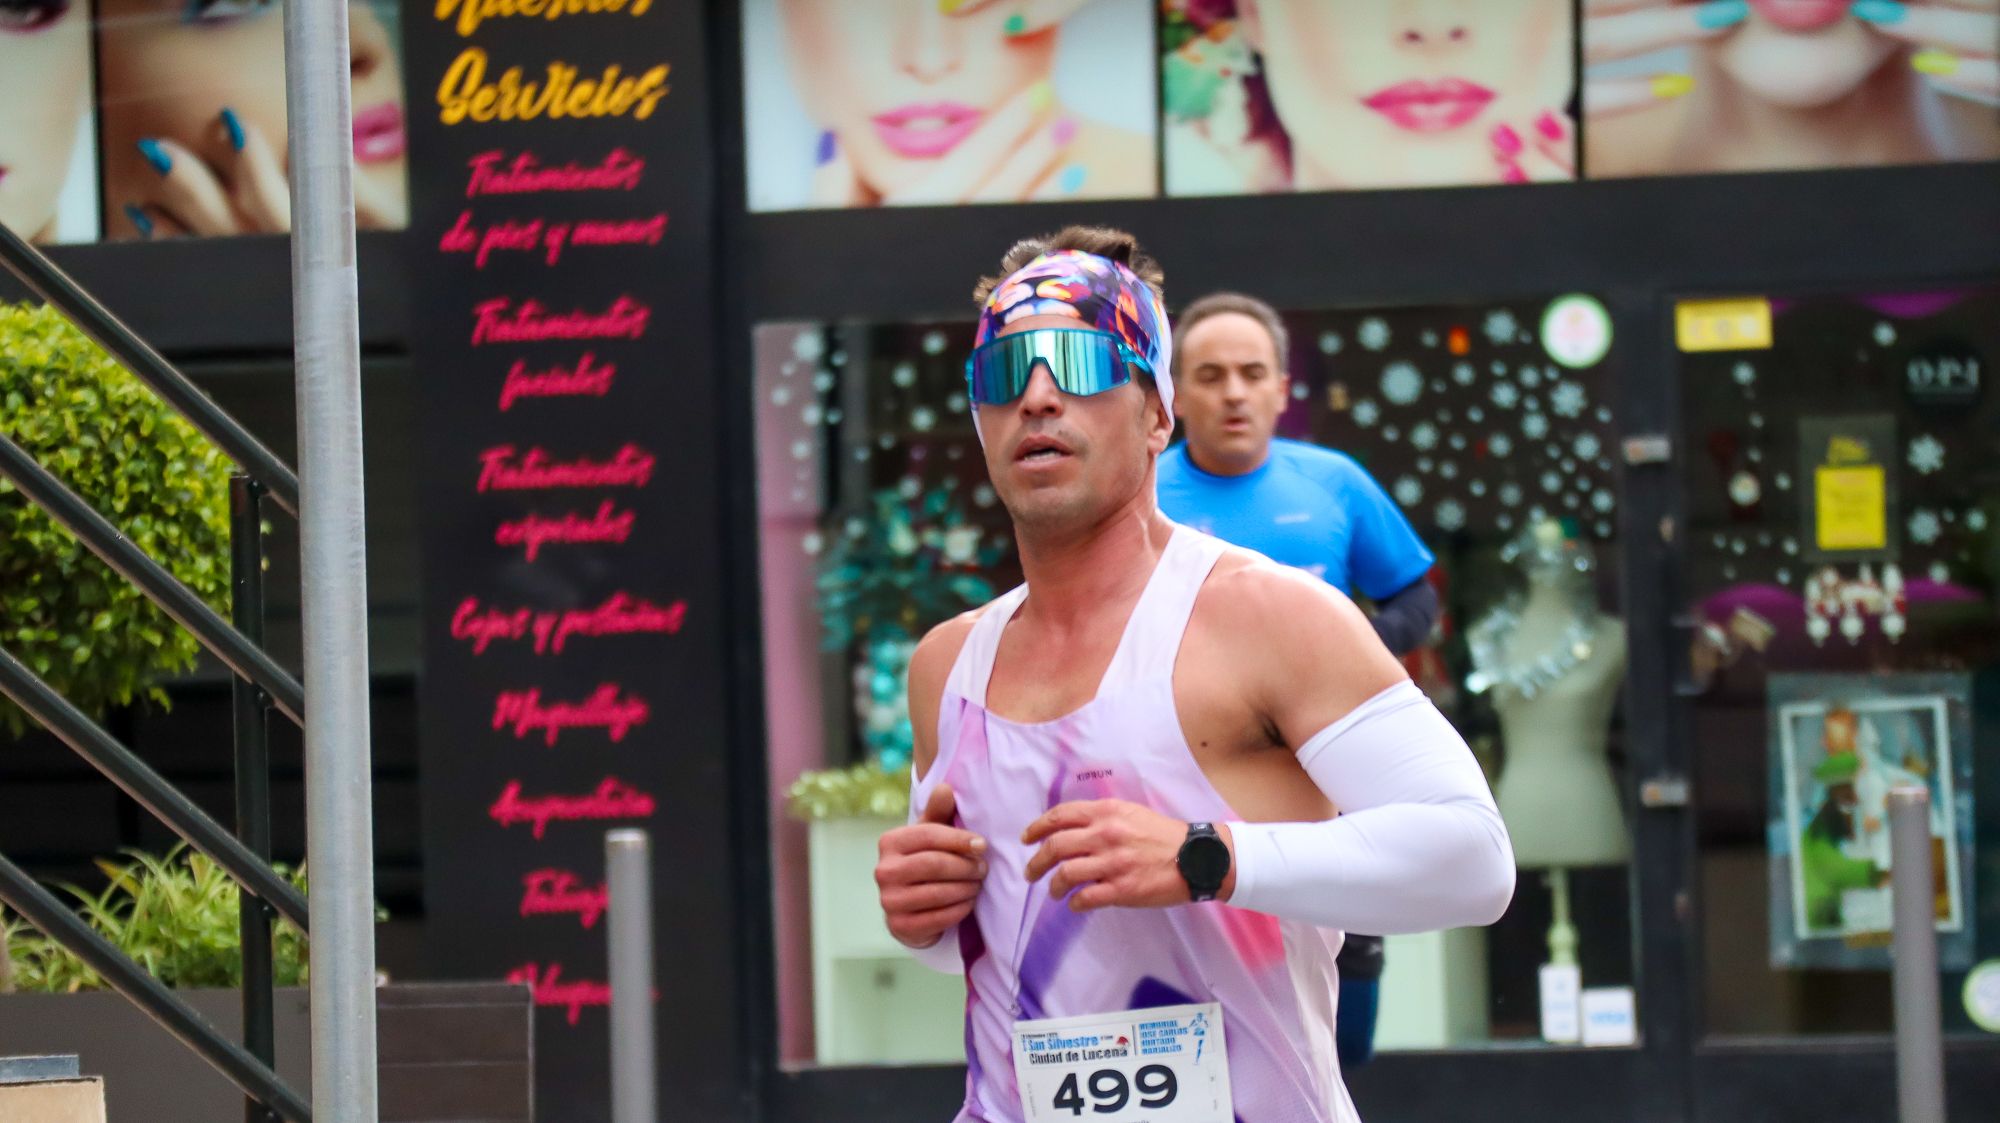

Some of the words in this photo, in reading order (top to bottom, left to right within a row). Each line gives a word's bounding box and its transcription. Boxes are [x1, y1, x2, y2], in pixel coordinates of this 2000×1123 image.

[437, 47, 669, 124] Servicios
[440, 210, 477, 252] de
[545, 224, 570, 266] y
[533, 612, 557, 655] y
[492, 683, 649, 747] Maquillaje
[1028, 1039, 1045, 1051] San
[1047, 1035, 1099, 1050] Silvestre
[1029, 1051, 1063, 1065] Ciudad
[1065, 1050, 1079, 1062] de
[1082, 1047, 1128, 1061] Lucena
[1053, 1064, 1178, 1116] 499
